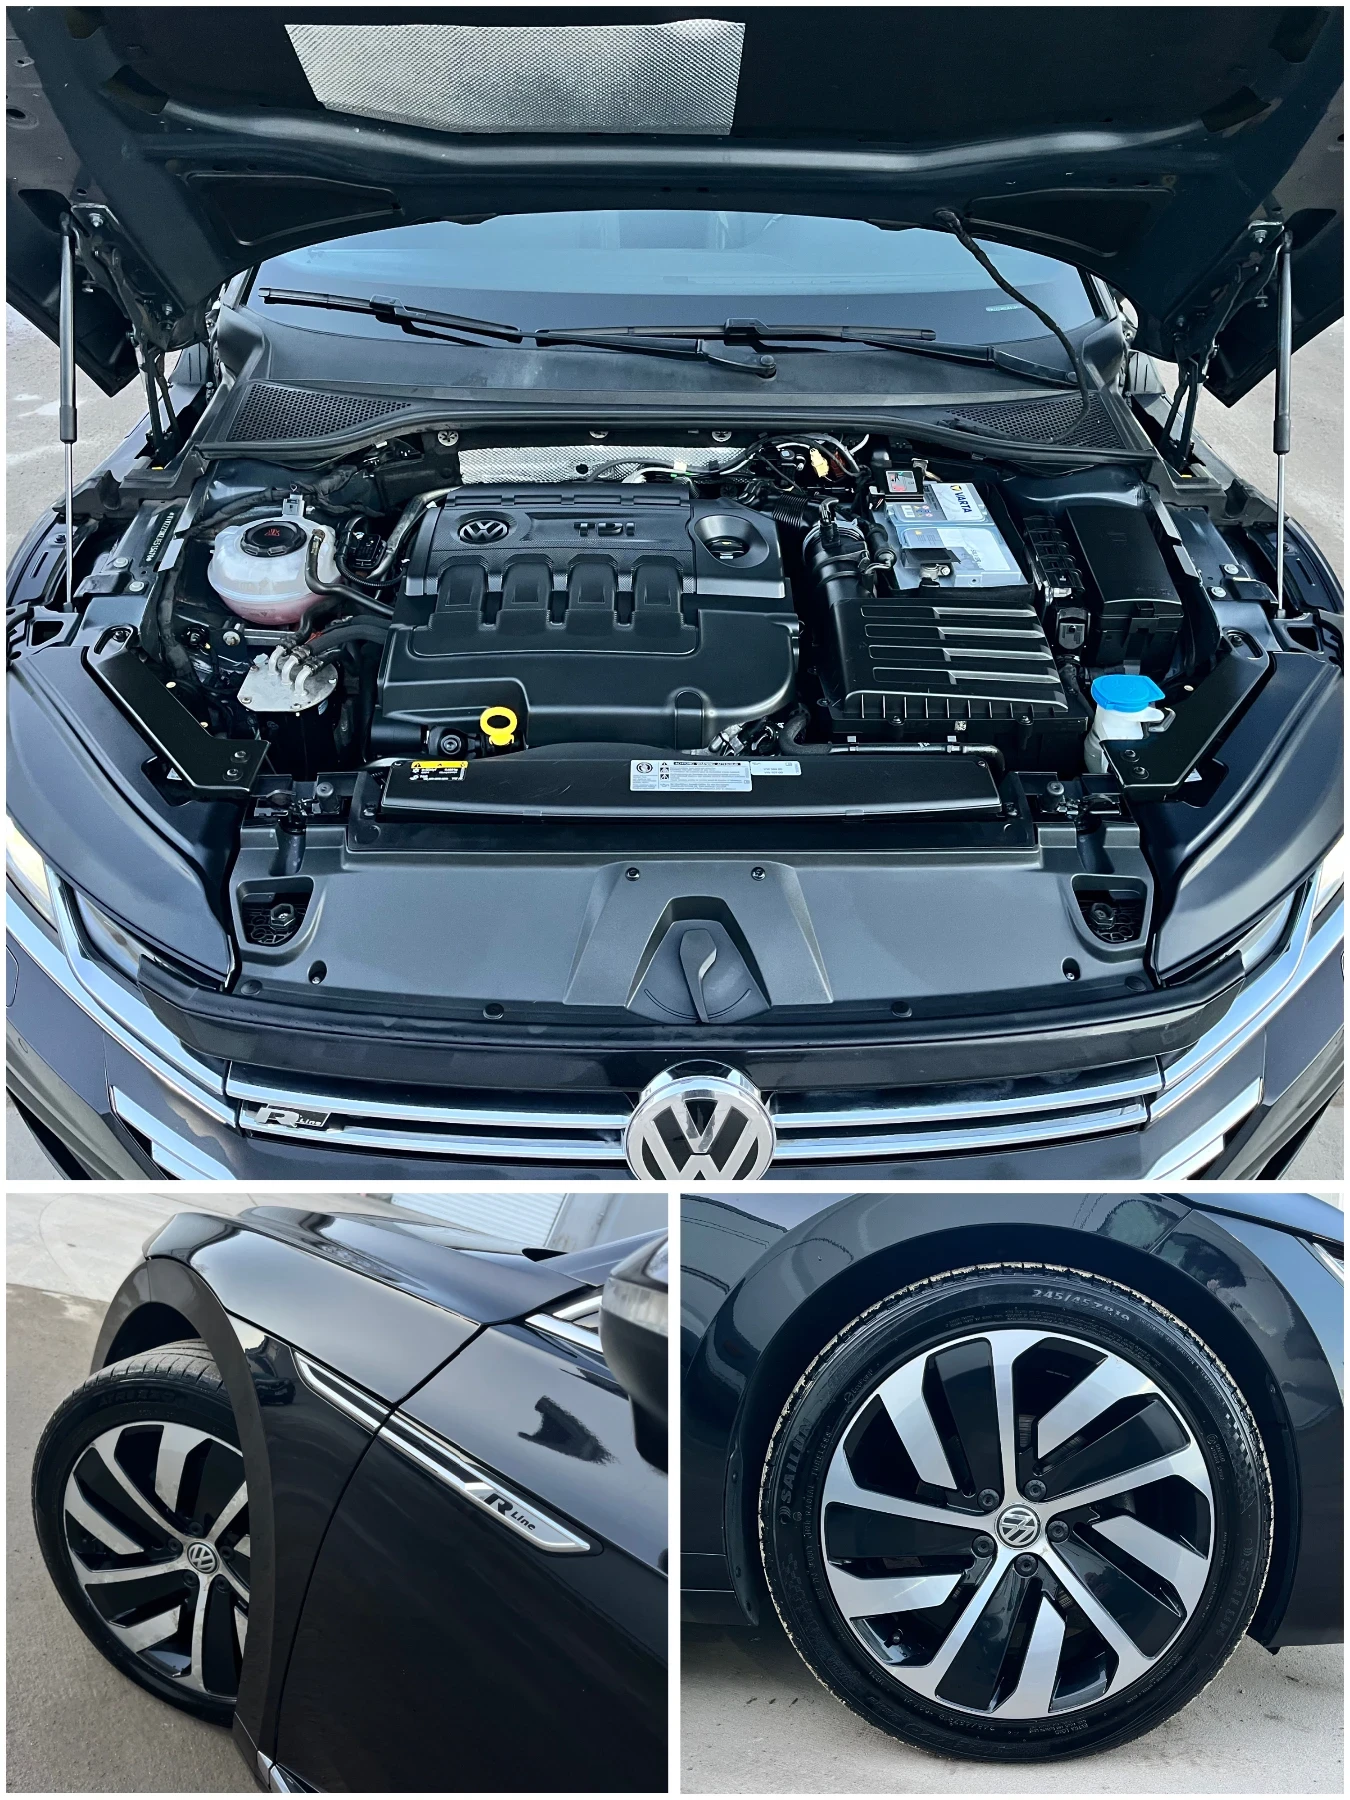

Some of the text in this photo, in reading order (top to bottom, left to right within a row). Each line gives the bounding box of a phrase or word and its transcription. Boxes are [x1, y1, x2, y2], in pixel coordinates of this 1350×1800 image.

[955, 491, 972, 513] VARTA
[573, 521, 636, 537] TDI
[781, 1417, 812, 1505] SAILUN
[483, 1492, 536, 1531] R Line
